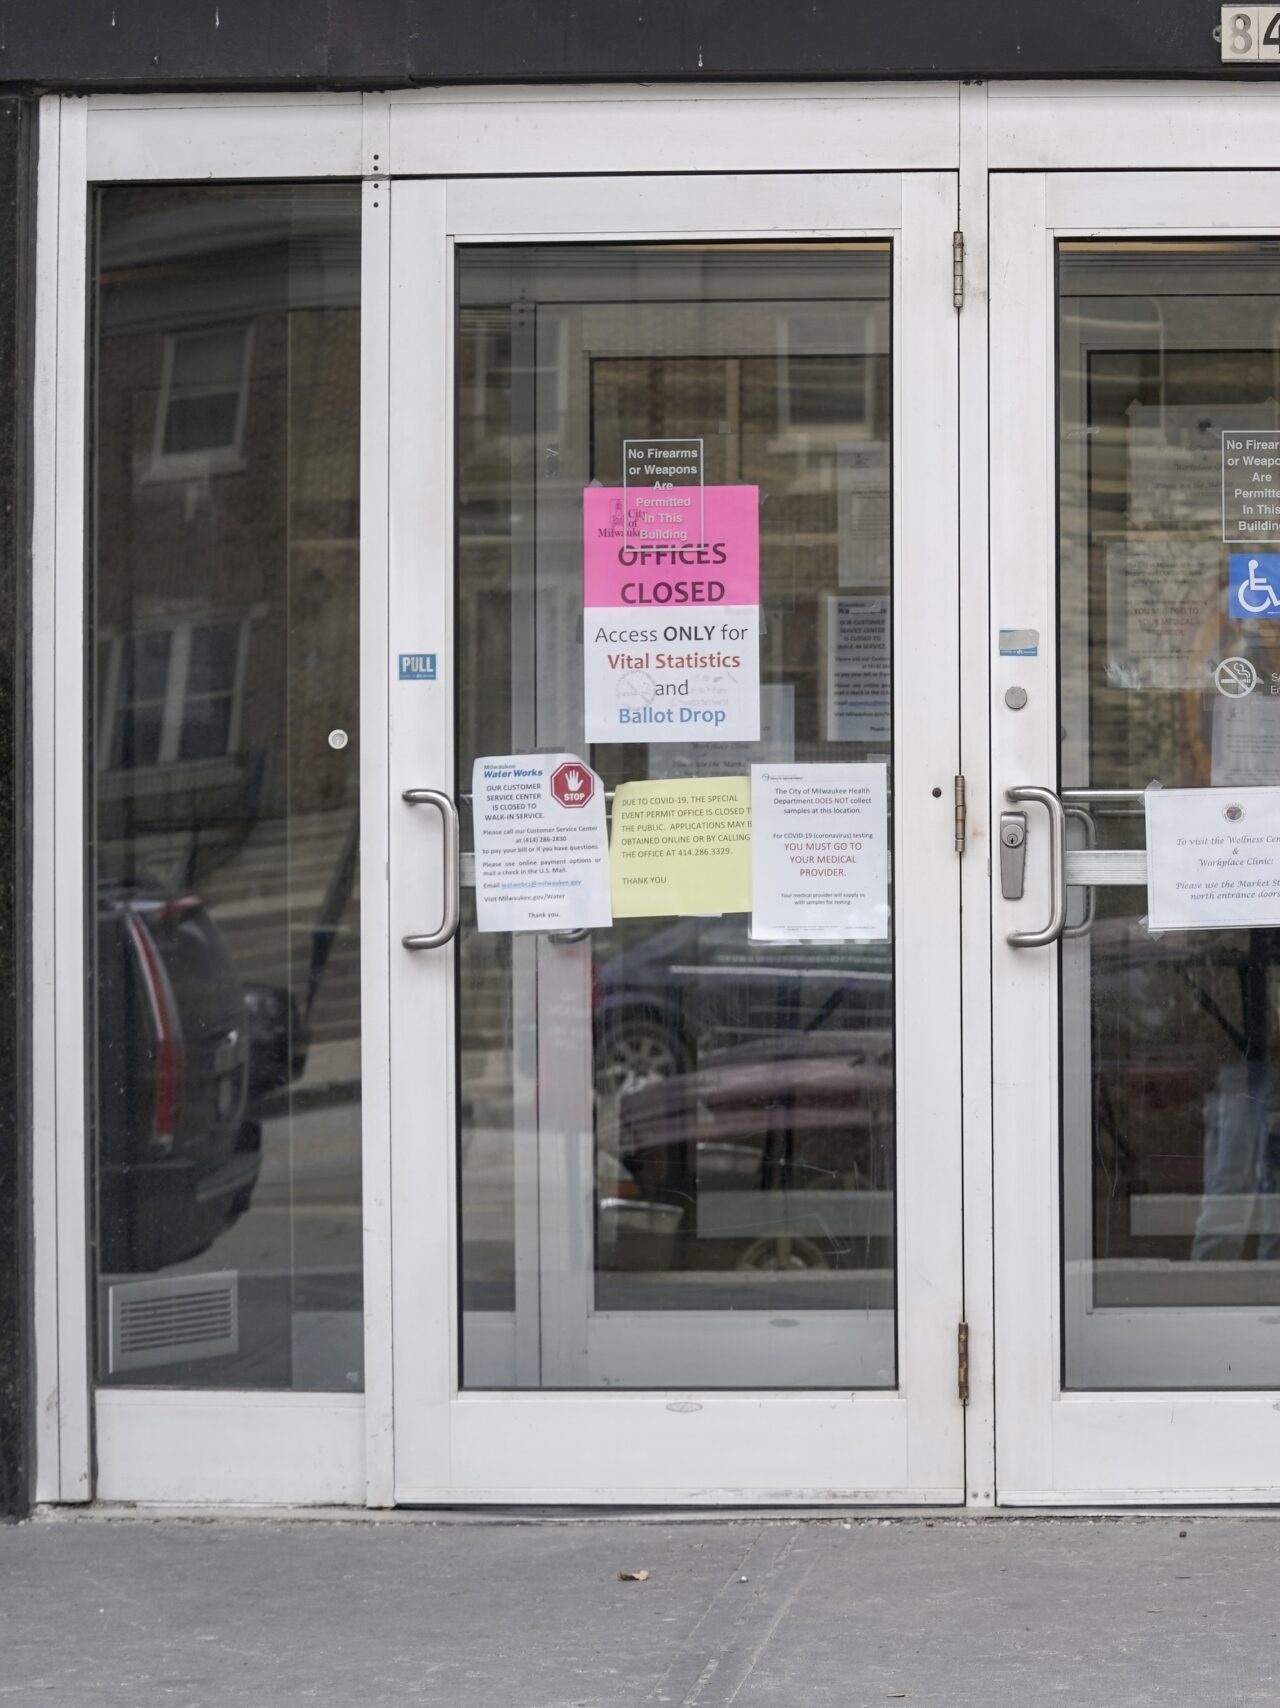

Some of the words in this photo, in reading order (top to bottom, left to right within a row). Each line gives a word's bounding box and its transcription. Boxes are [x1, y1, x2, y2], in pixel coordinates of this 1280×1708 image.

[1227, 440, 1242, 449] No
[628, 449, 644, 459] No
[648, 449, 698, 458] Firearms
[629, 466, 641, 475] or
[644, 465, 698, 477] Weapons
[1252, 472, 1272, 481] Are
[654, 481, 673, 490] Are
[636, 497, 690, 507] Permitted
[1243, 505, 1253, 514] In
[1257, 505, 1280, 514] This
[644, 513, 654, 523] In
[657, 513, 683, 523] This
[640, 529, 687, 541] Building
[618, 543, 727, 566] OFFICES
[621, 581, 725, 604] CLOSED
[595, 628, 657, 643] Access
[663, 626, 715, 641] ONLY
[720, 624, 748, 640] for
[402, 656, 433, 672] PULL
[607, 653, 649, 669] Vital
[655, 652, 741, 669] Statistics
[655, 679, 689, 696] and
[619, 707, 673, 724] Ballot
[680, 707, 726, 726] Drop
[484, 769, 511, 779] Water
[514, 768, 543, 777] Works
[503, 783, 541, 791] CUSTOMER
[564, 793, 585, 801] STOP
[622, 798, 636, 807] DUE
[637, 798, 648, 806] TO
[649, 796, 689, 805] COVID-19,
[691, 795, 706, 803] THE
[707, 794, 739, 803] SPECIAL
[621, 811, 644, 819] EVENT
[646, 810, 675, 818] PERMIT
[677, 809, 703, 817] OFFICE
[706, 808, 713, 816] IS
[714, 807, 745, 816] CLOSED
[637, 824, 665, 832] PUBLIC.
[670, 821, 725, 831] APPLICATIONS
[621, 837, 660, 845] OBTAINED
[662, 836, 690, 844] ONLINE
[693, 835, 704, 843] OR
[718, 834, 750, 842] CALLING
[1176, 838, 1187, 846] To
[1189, 837, 1209, 845] visit
[1211, 836, 1224, 845] the
[1227, 836, 1263, 844] Wellness
[638, 850, 663, 858] OFFICE
[678, 848, 732, 856] 414.286.3329.
[1198, 858, 1244, 868] Workplace
[623, 877, 648, 885] THANK
[650, 876, 667, 884] YOU
[1176, 881, 1201, 890] Please
[1221, 880, 1234, 888] the
[1237, 879, 1269, 888] Market
[1190, 892, 1214, 900] north
